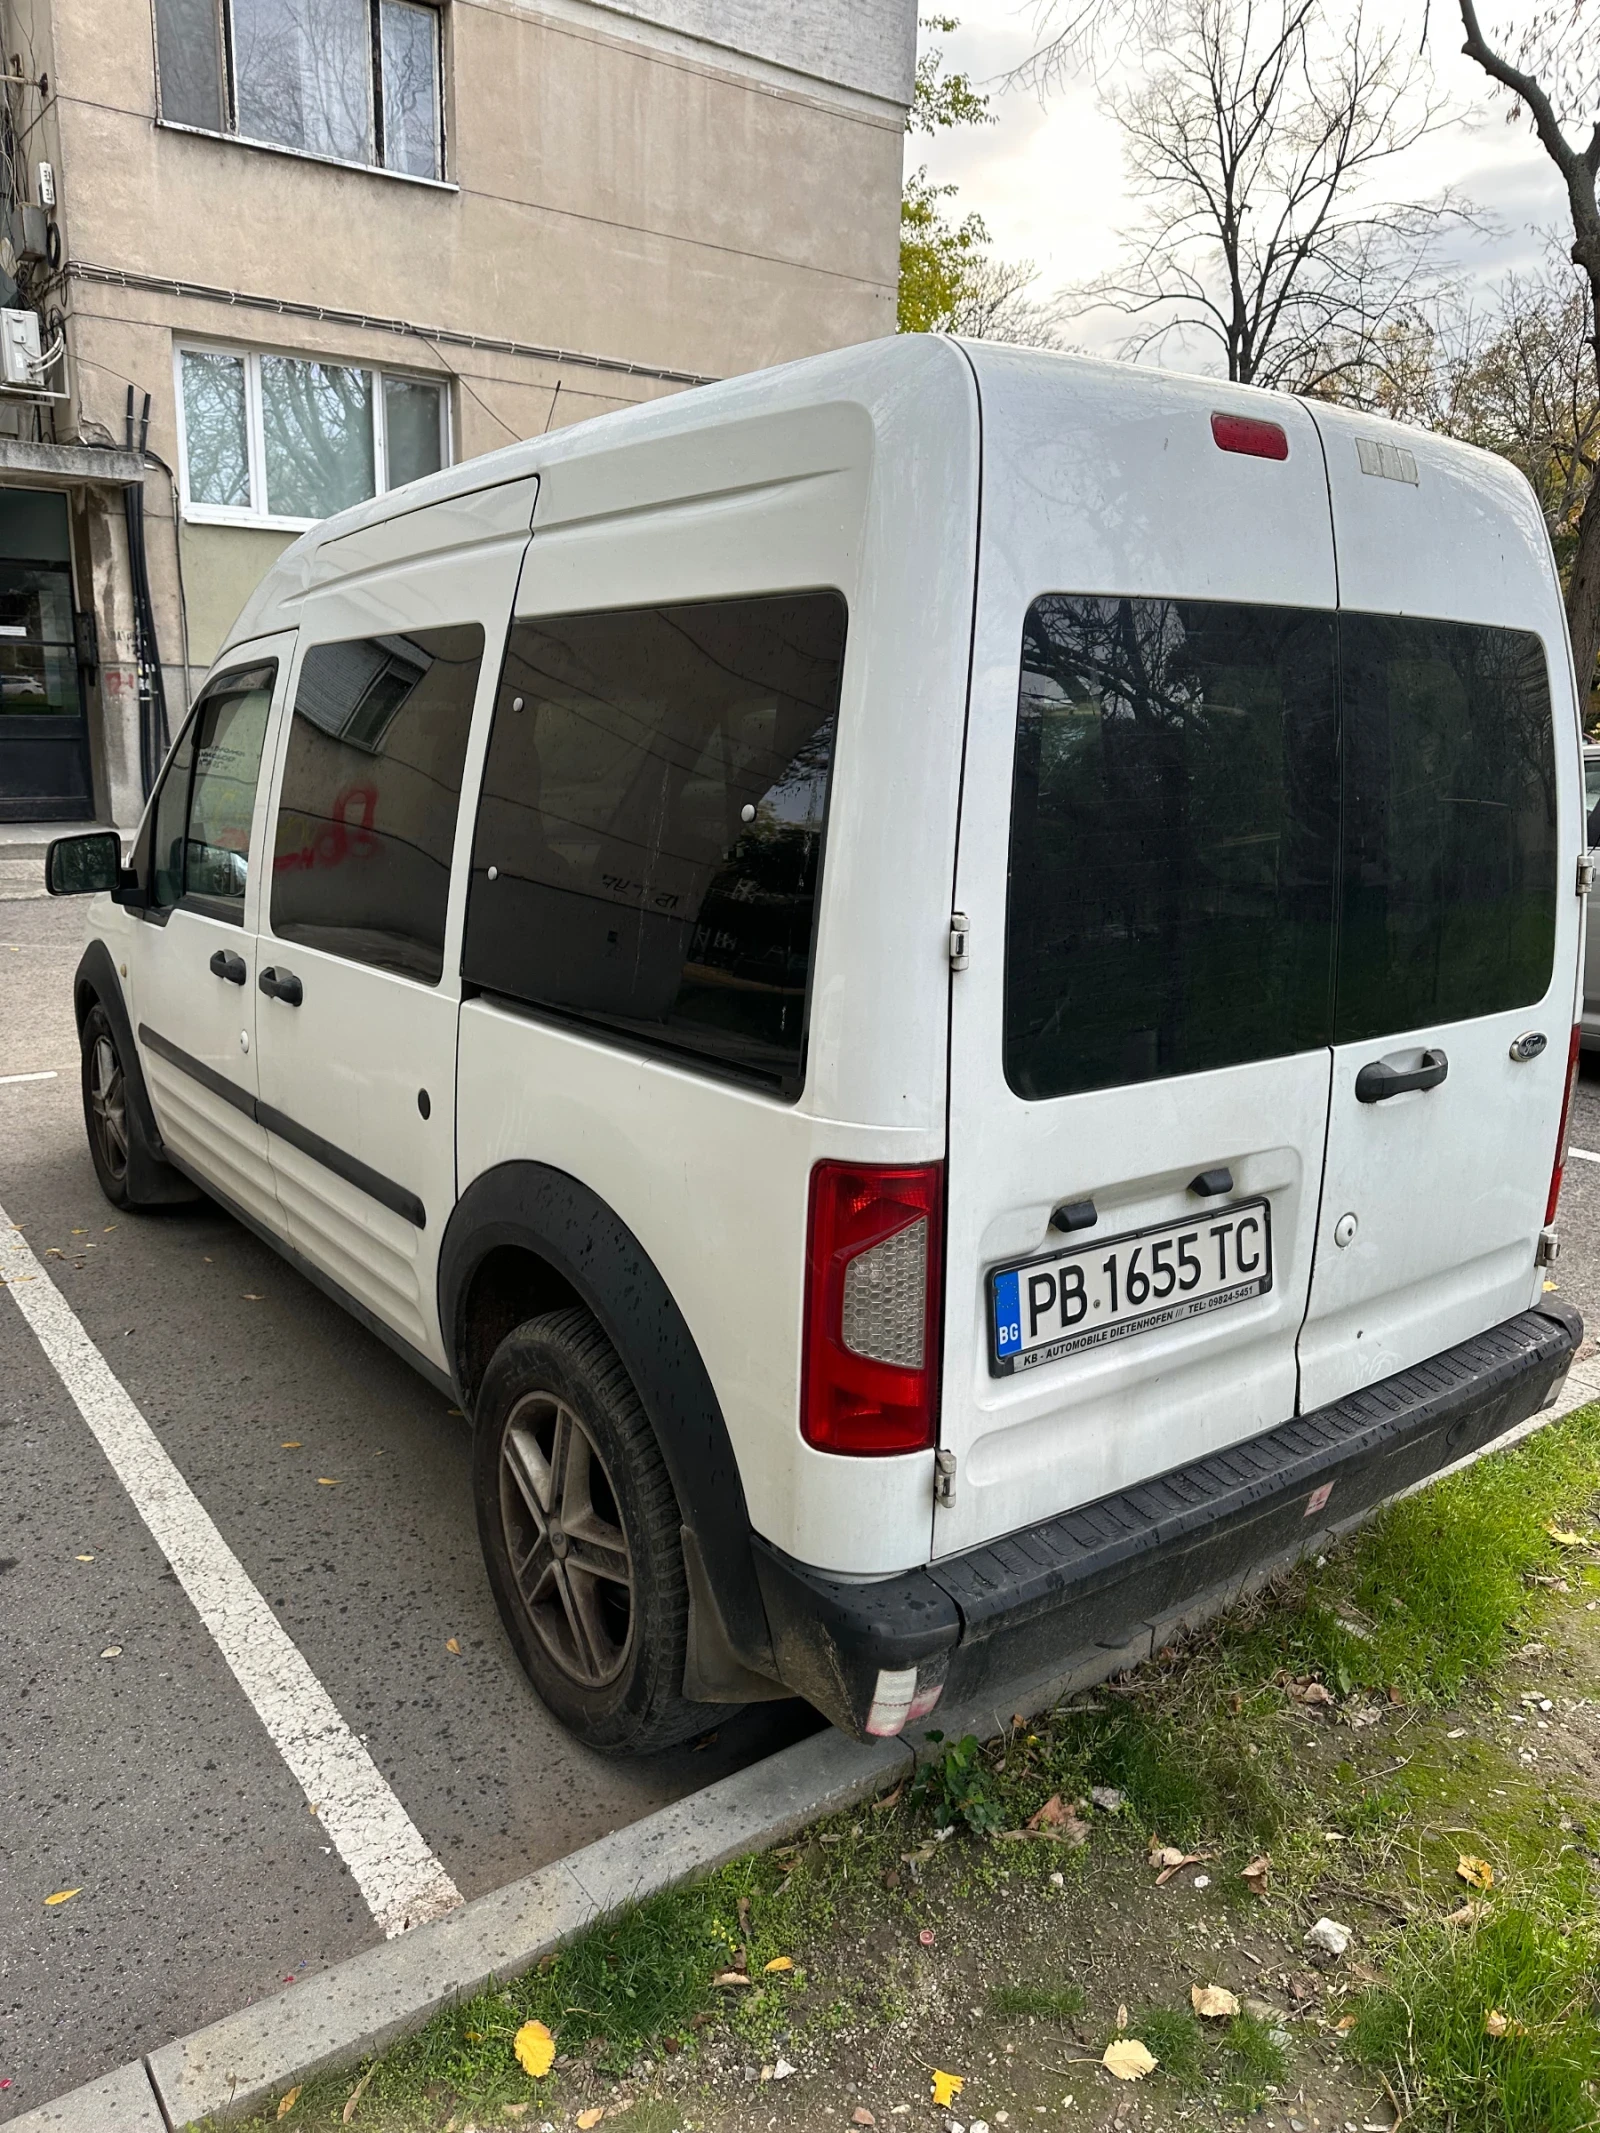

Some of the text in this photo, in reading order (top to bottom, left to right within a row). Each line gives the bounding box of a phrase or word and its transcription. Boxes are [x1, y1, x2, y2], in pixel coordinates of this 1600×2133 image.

[1027, 1217, 1260, 1338] PB 1655 TC
[999, 1322, 1019, 1345] BG
[1023, 1353, 1038, 1366] KB
[1046, 1331, 1108, 1359] AUTOMOBILE
[1110, 1310, 1174, 1338] DIETENHOFEN
[1188, 1302, 1206, 1314] TEL:
[1208, 1285, 1253, 1307] 09824-5451
